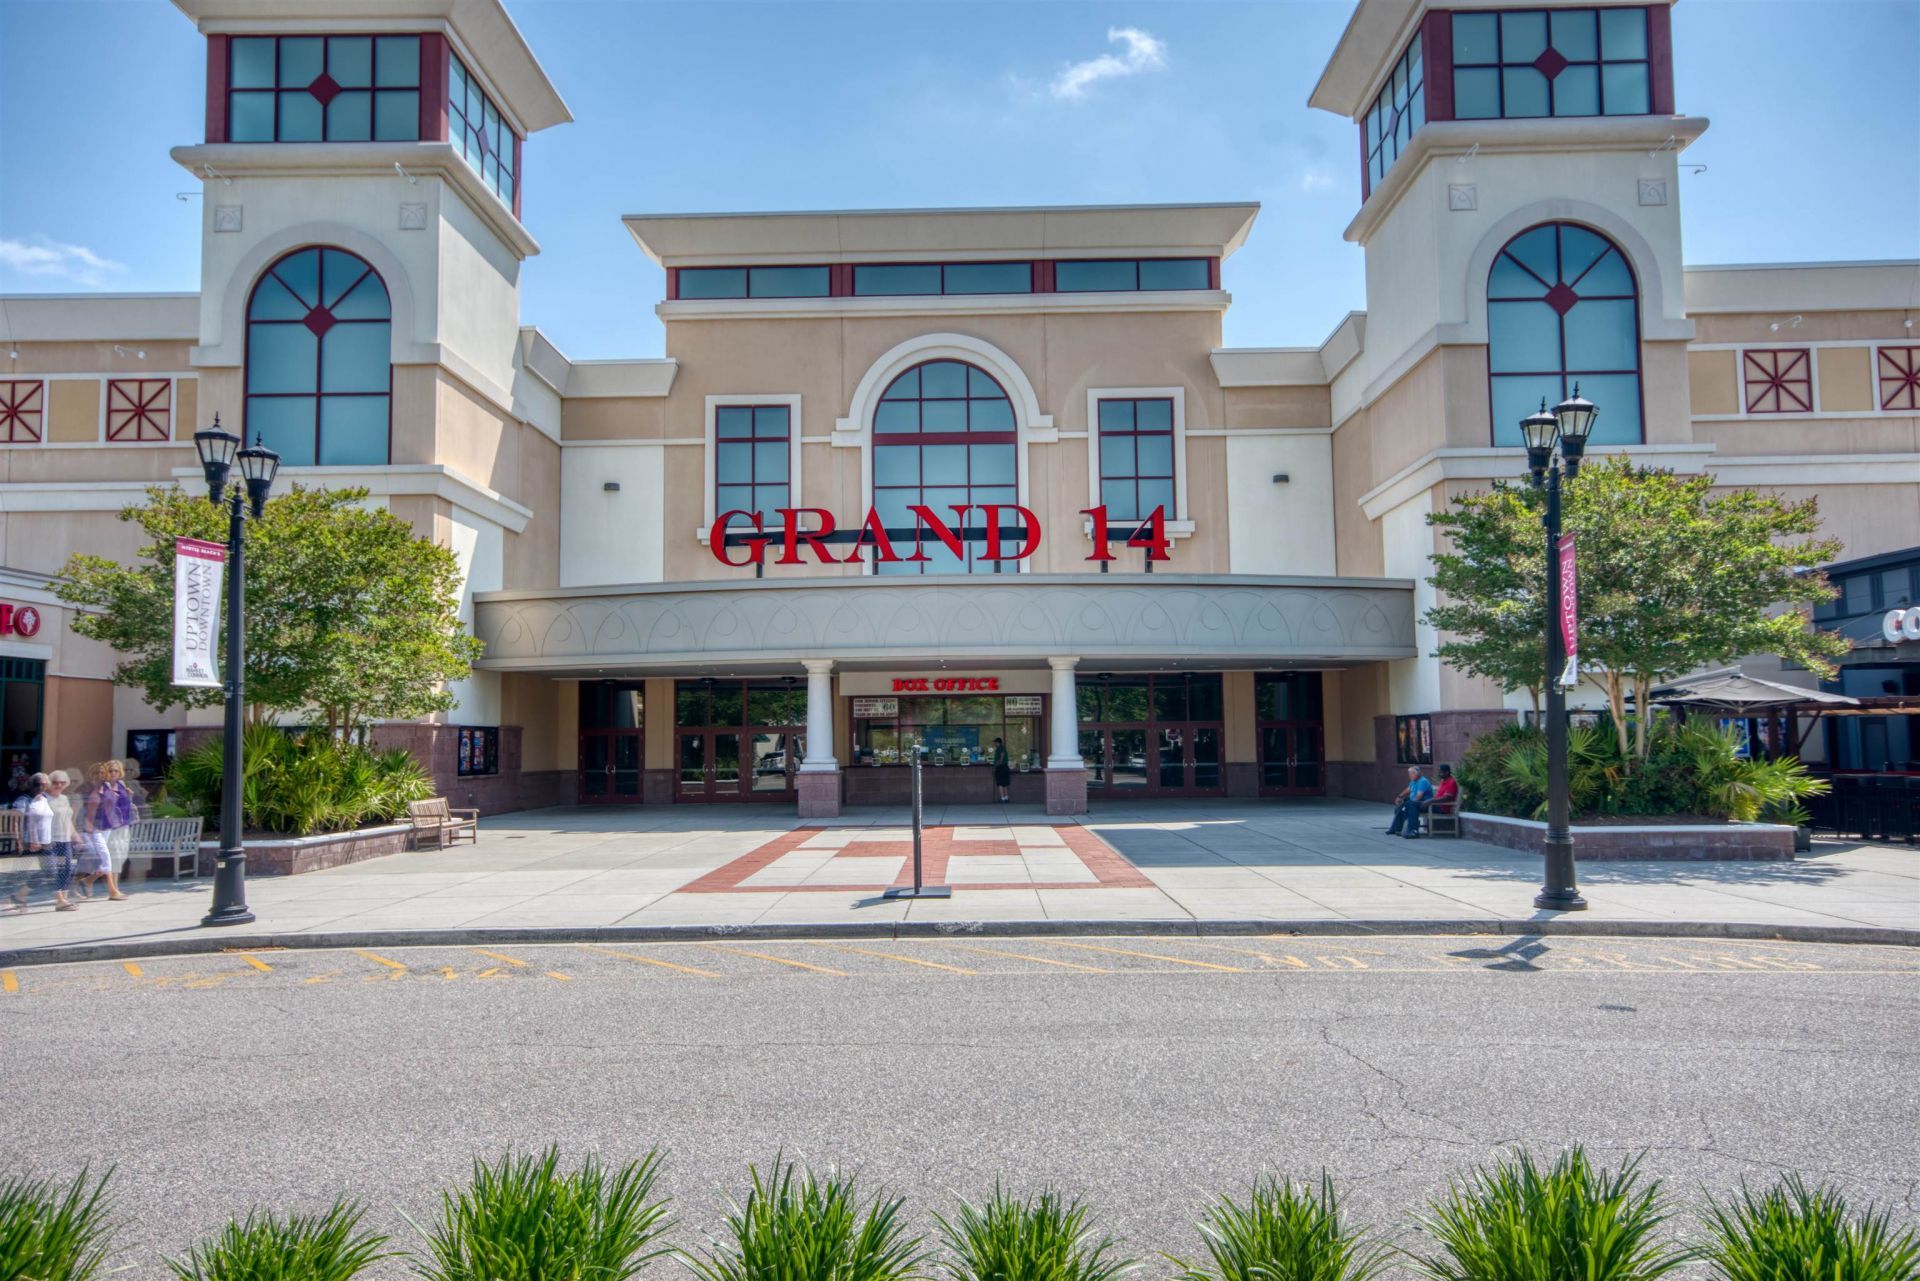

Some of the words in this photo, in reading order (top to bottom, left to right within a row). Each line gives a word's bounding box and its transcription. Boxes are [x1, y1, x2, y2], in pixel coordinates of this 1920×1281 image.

[709, 504, 1041, 568] GRAND
[1079, 504, 1171, 562] 14
[186, 562, 201, 650] UPTOWN
[198, 564, 212, 651] DOWNTOWN
[892, 678, 929, 691] BOX
[933, 677, 999, 691] OFFICE
